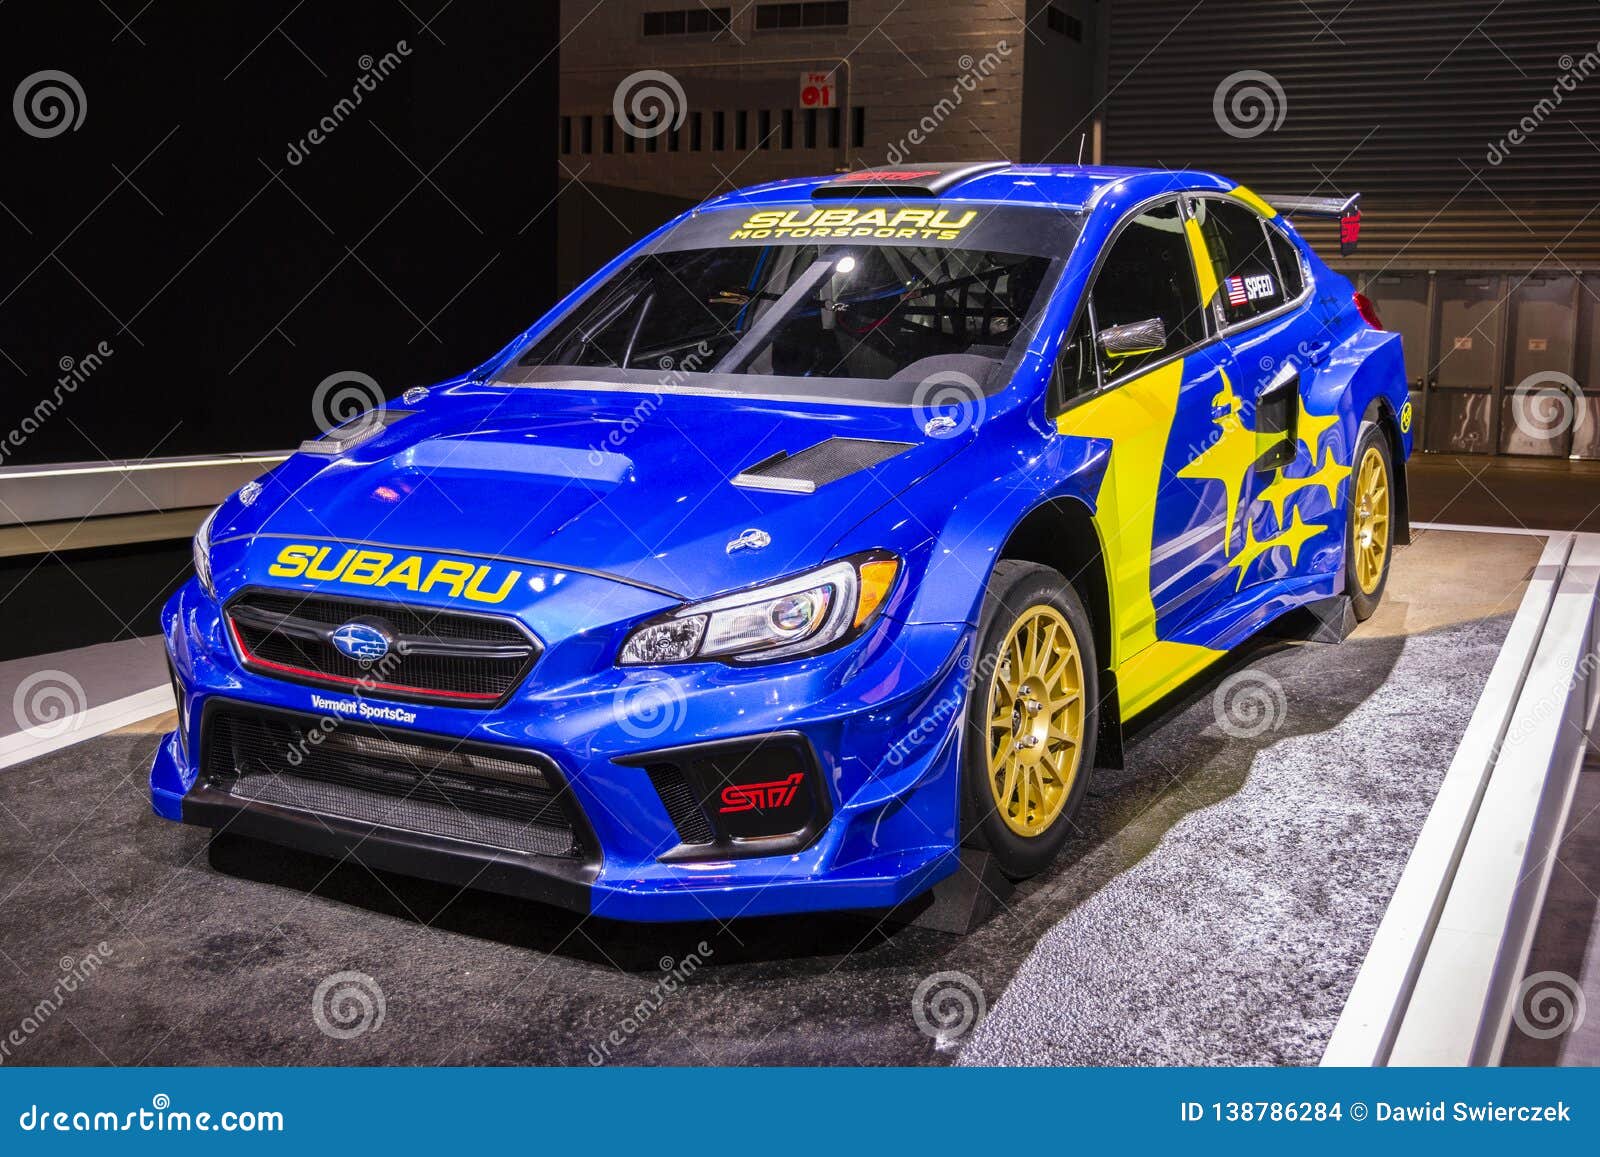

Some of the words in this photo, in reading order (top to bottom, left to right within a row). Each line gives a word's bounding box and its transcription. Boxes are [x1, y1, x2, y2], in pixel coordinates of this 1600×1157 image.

[742, 208, 977, 230] SUBARU
[729, 227, 961, 240] MOTORSPORTS
[1244, 274, 1274, 300] SPEED
[268, 544, 522, 604] SUBARU
[311, 694, 358, 714] Vermont
[359, 702, 417, 723] SportsCar
